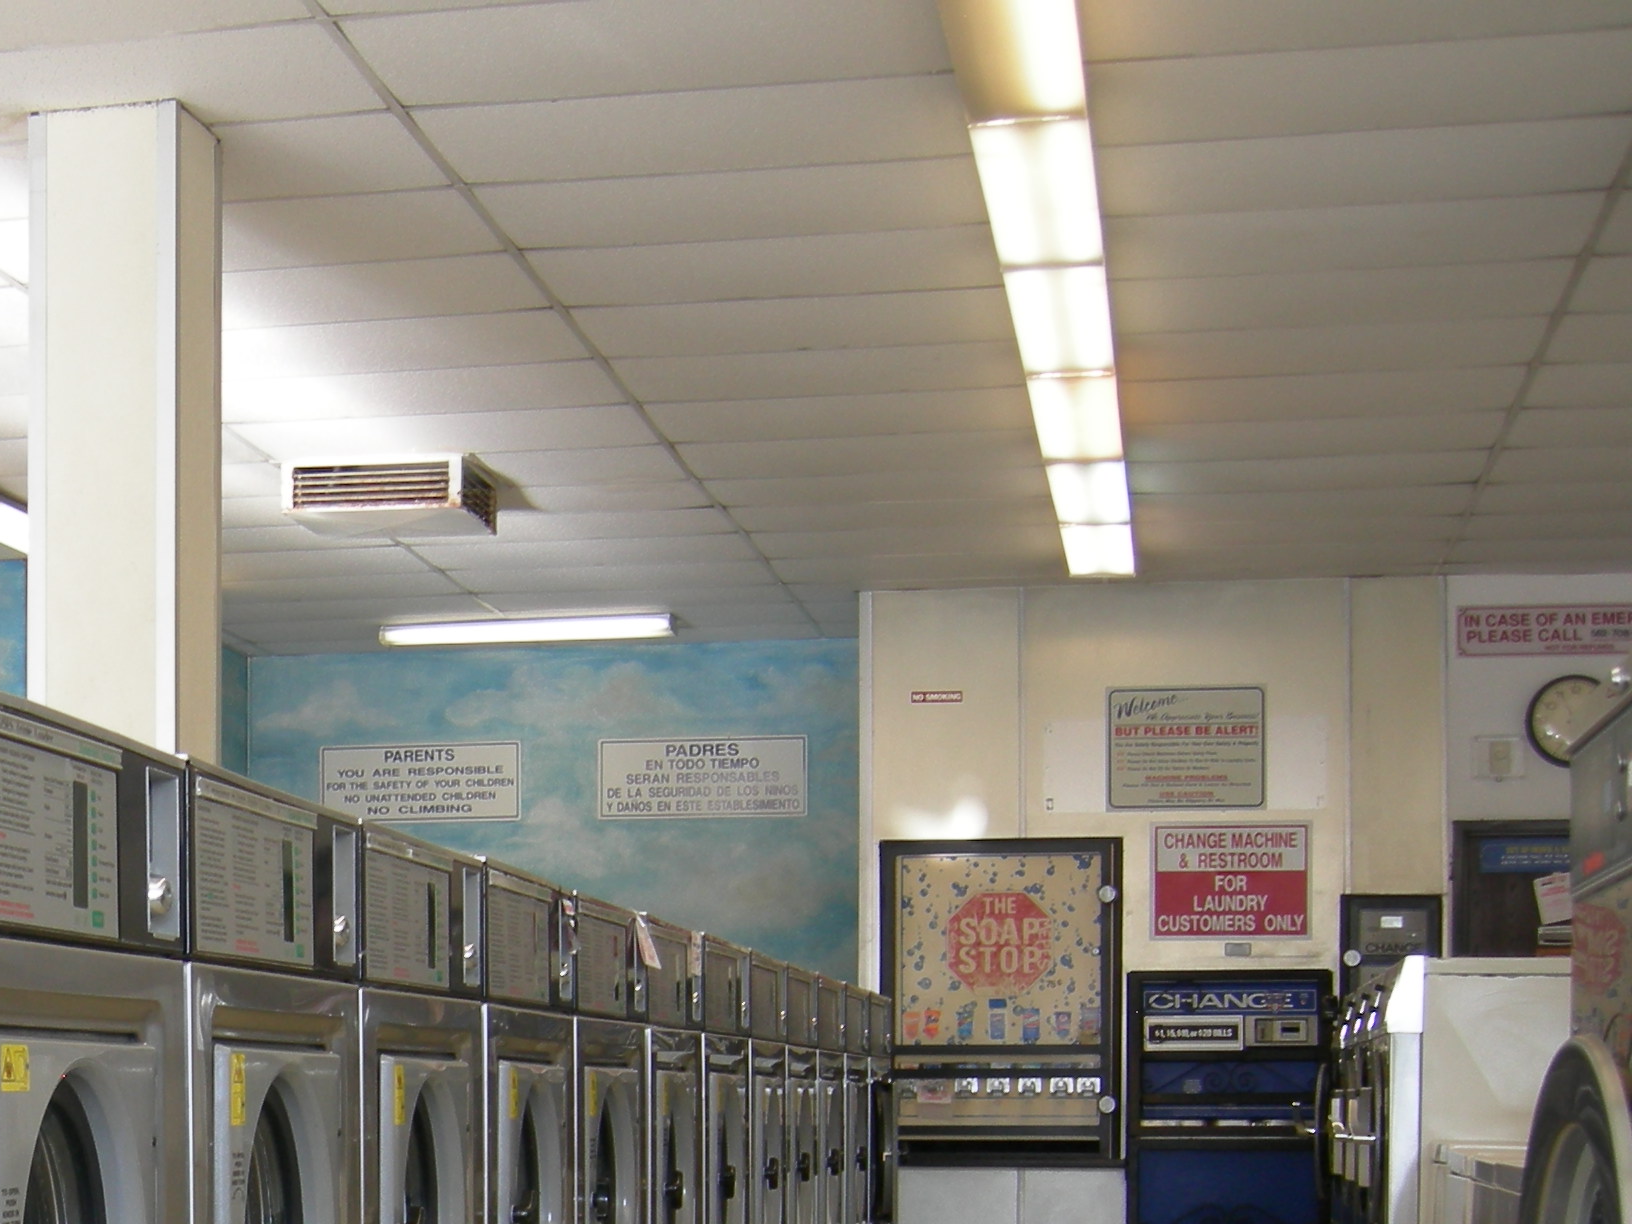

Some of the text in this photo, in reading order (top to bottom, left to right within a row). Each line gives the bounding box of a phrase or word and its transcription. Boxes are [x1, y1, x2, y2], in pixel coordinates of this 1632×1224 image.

[1464, 615, 1479, 627] IN
[1485, 613, 1530, 627] CASE
[1536, 613, 1558, 626] OF
[1563, 612, 1585, 625] AN
[1467, 630, 1532, 643] PLEASE
[1538, 629, 1582, 641] CALL
[1115, 725, 1258, 736] BUT PLEASE BE ALERT!
[384, 749, 455, 763] PARENTS
[665, 743, 739, 757] PADRES
[645, 758, 759, 770] EN TODO TIEMPO
[337, 765, 504, 778] YOU ARE RESPONSIBLE
[626, 771, 780, 785] SERAN RESPONSABLES
[327, 778, 514, 791] FOR THE SAFETY OF YOUR CHILDREN
[607, 788, 621, 798] DE
[627, 788, 642, 798] LA
[648, 786, 711, 797] SEGURIDAD
[717, 786, 731, 796] DE
[737, 785, 759, 796] LOS
[344, 791, 496, 803] NO UNATTENDED CHILDREN
[367, 804, 472, 815] NO CLIMBING
[607, 802, 614, 812] Y
[657, 801, 671, 811] EN
[676, 800, 702, 811] ESTE
[1164, 832, 1297, 849] CHANGE MACHINE
[1179, 852, 1282, 869] & RESTROOM
[1215, 875, 1247, 892] FOR
[983, 897, 1016, 914] THE
[1193, 895, 1268, 912] LAUNDRY
[1158, 914, 1304, 931] CUSTOMERS ONLY
[959, 918, 1039, 945] SOAP
[958, 946, 1041, 973] STOP
[1149, 993, 1293, 1009] CHANGE
